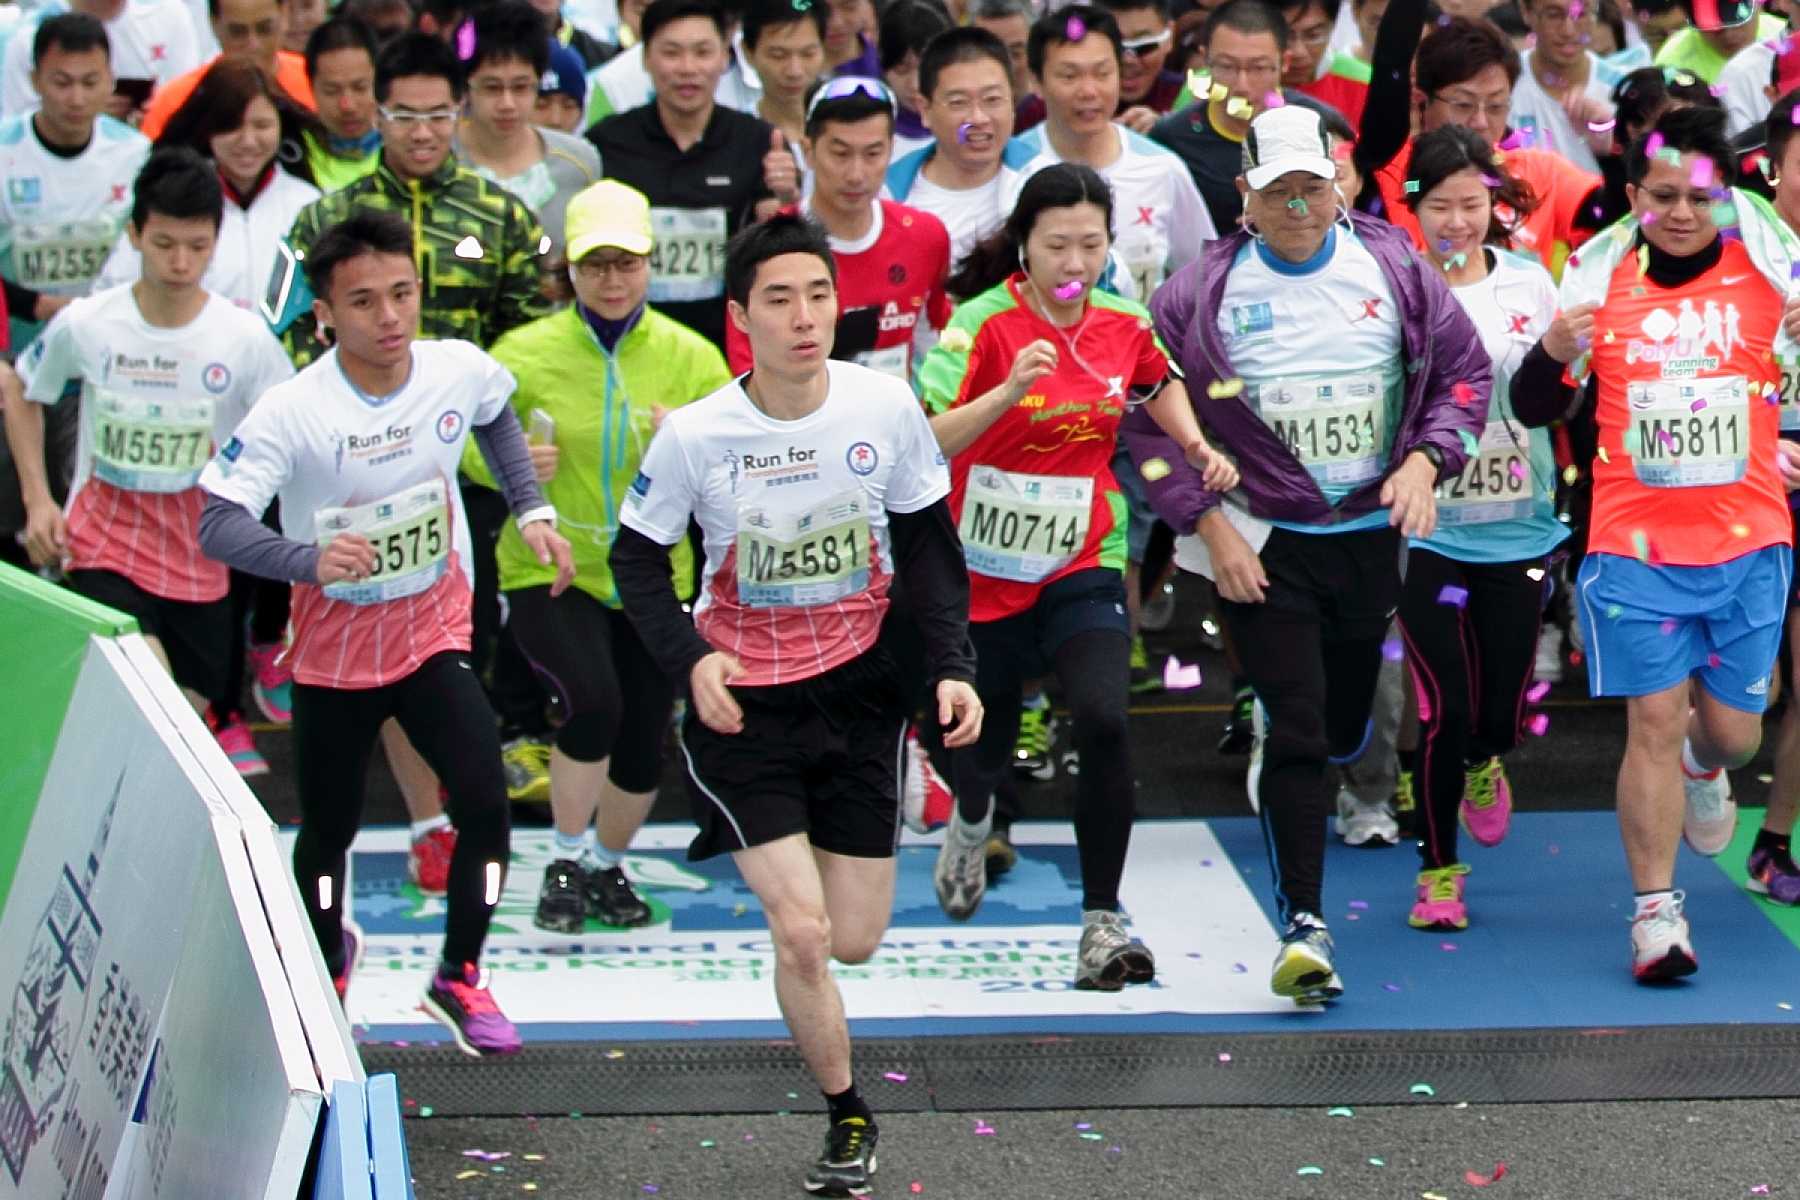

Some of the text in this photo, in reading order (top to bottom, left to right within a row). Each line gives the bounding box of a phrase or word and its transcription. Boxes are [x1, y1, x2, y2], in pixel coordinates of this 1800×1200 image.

[116, 353, 178, 370] Run for
[1626, 338, 1693, 365] PolyU
[1668, 357, 1718, 370] running
[1662, 367, 1696, 377] team
[101, 425, 204, 466] M5577
[348, 425, 412, 450] Run for
[1639, 413, 1740, 460] M5811
[743, 446, 818, 471] Run for
[969, 502, 1079, 555] M0714
[748, 527, 859, 584] M5581
